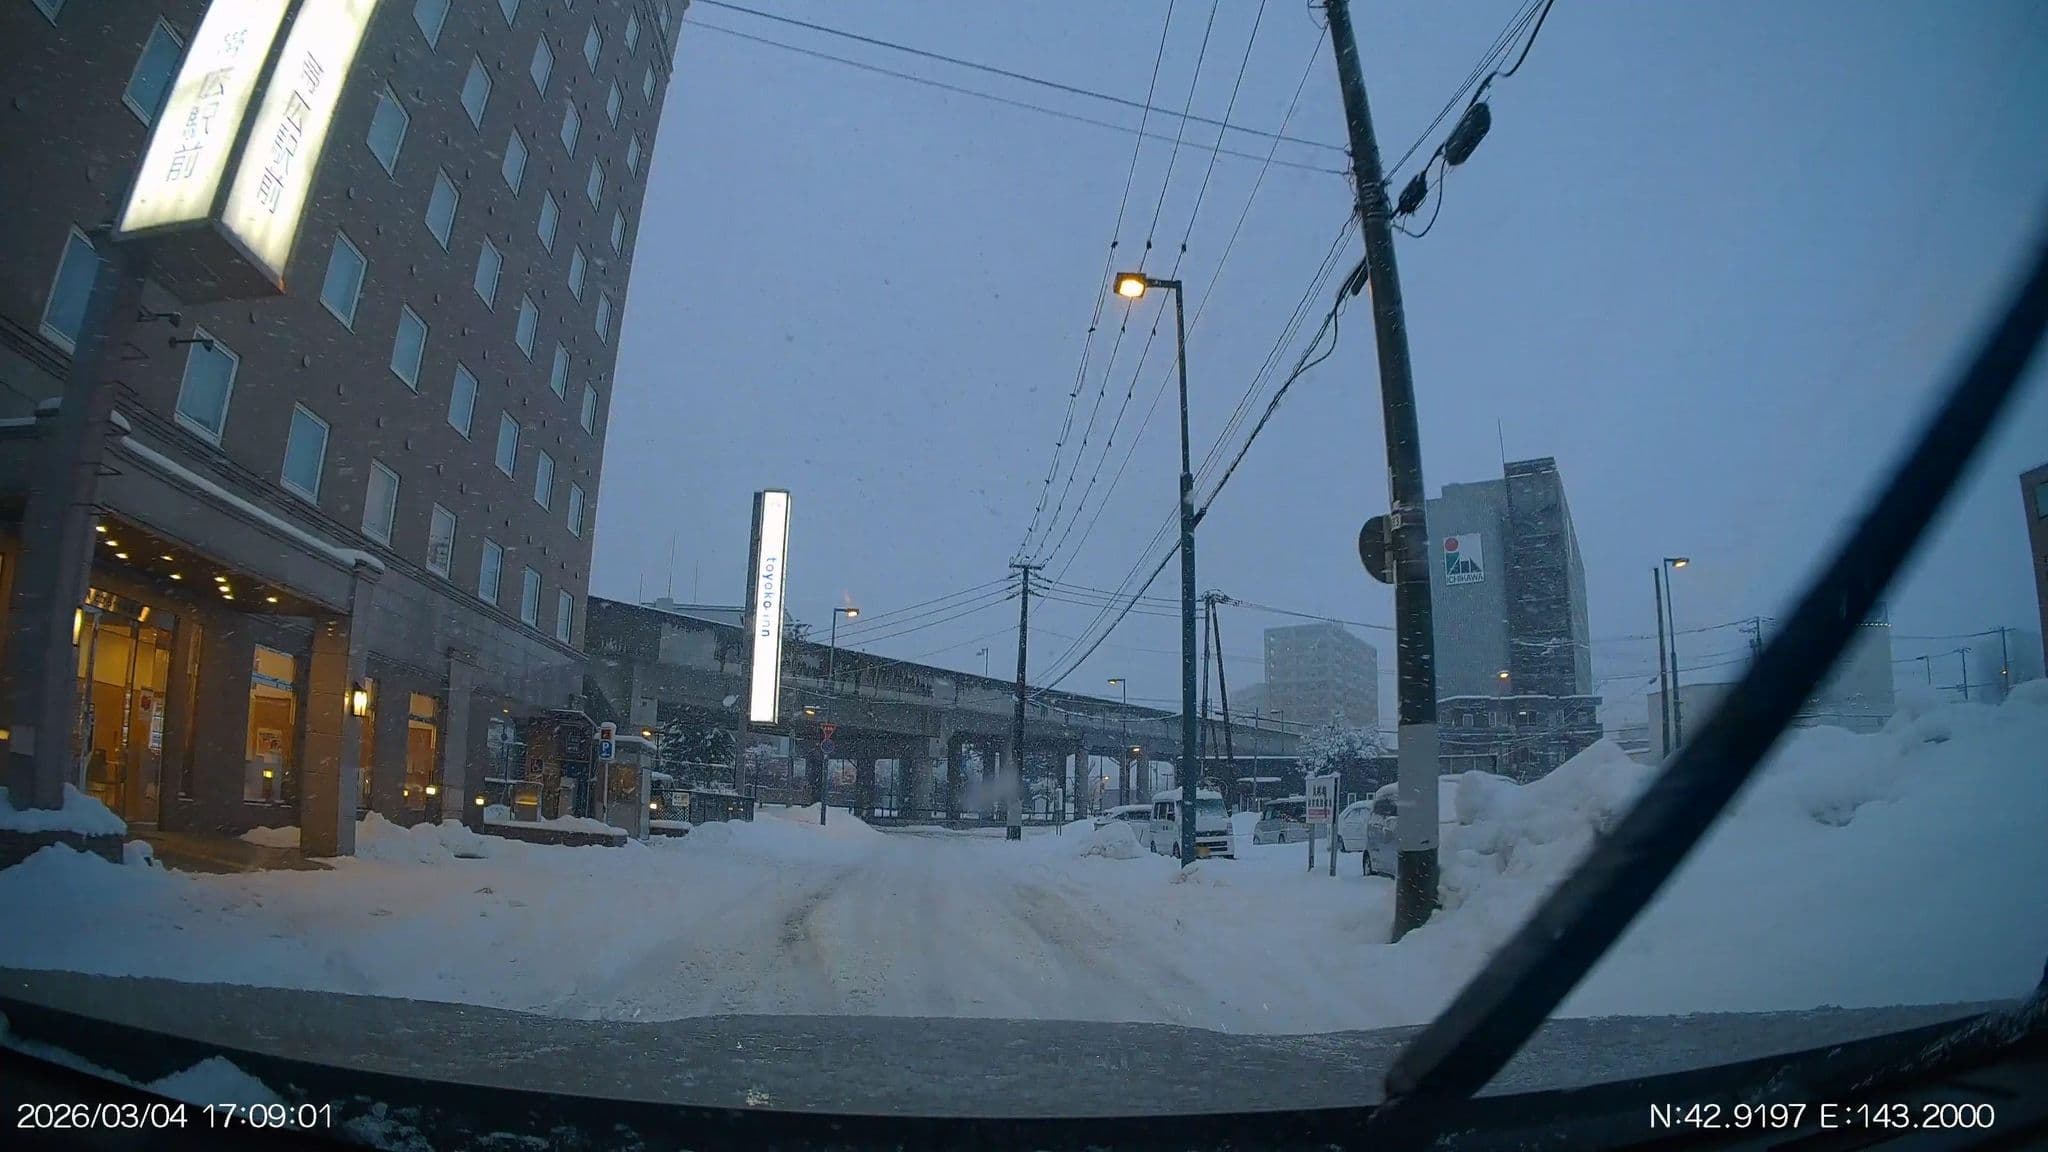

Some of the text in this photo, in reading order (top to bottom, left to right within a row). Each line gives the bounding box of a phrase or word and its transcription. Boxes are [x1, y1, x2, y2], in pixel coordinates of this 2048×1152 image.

[761, 557, 776, 638] toyoko inn
[1447, 573, 1483, 584] ICHIKAWA
